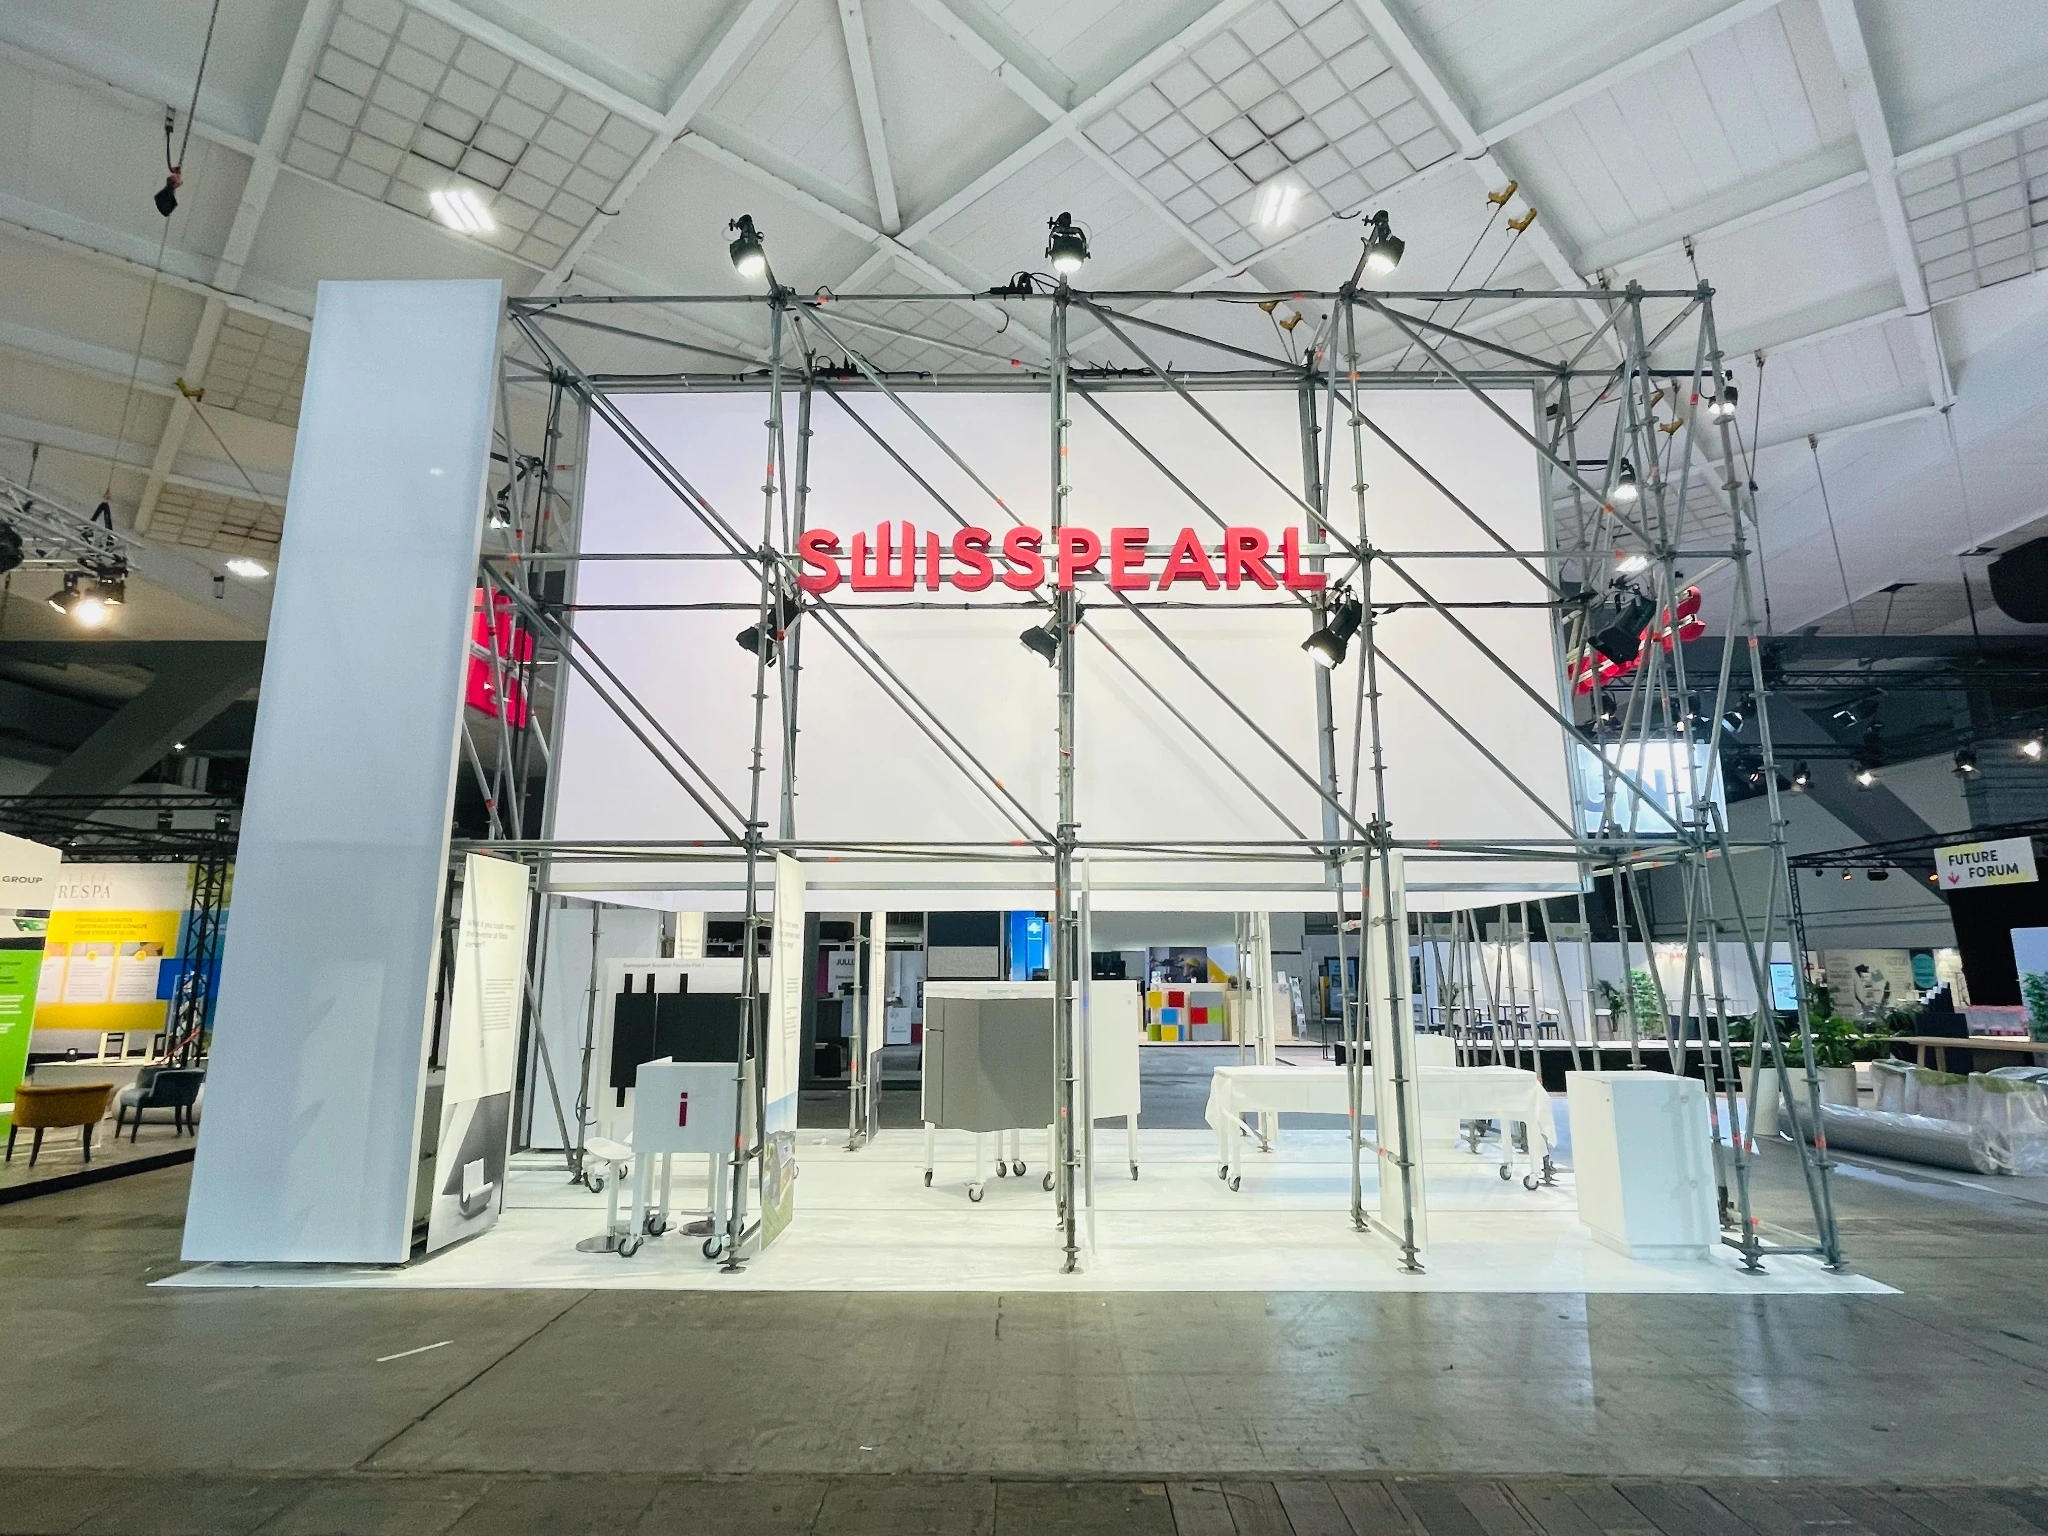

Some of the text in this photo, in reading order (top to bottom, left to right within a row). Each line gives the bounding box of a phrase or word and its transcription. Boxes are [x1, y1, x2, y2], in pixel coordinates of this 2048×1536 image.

[798, 520, 1328, 593] SWISSPEARL
[1948, 850, 1998, 866] FUTURE
[1968, 863, 2019, 878] FORUM
[2, 875, 42, 884] GROUP
